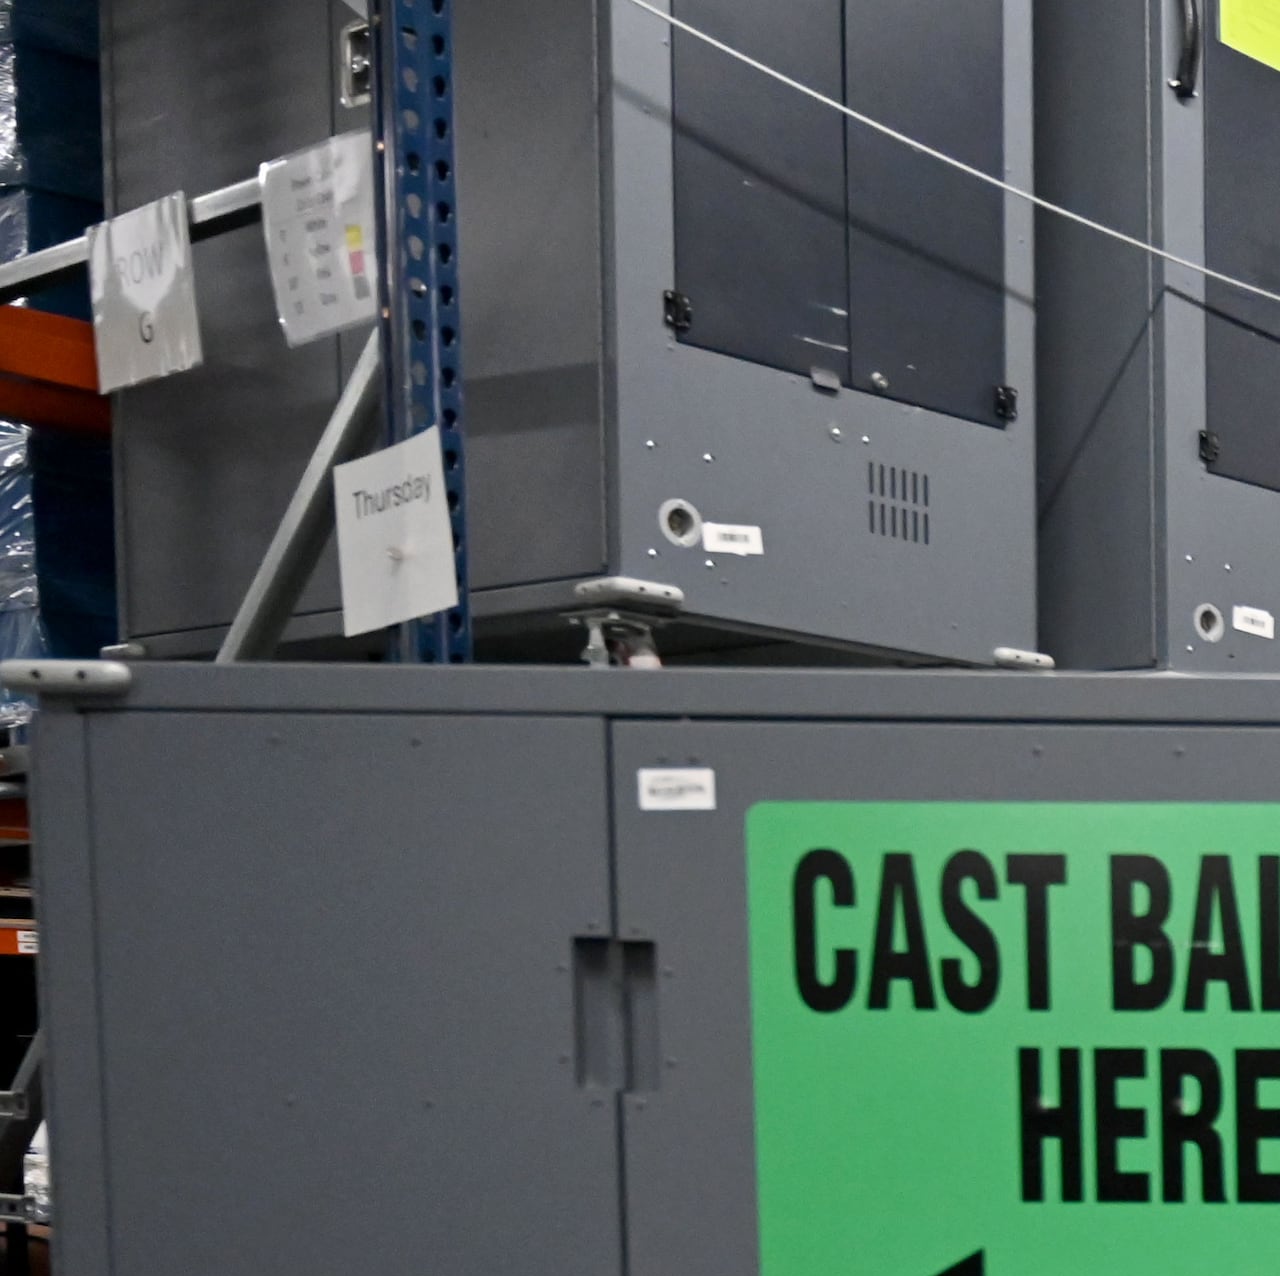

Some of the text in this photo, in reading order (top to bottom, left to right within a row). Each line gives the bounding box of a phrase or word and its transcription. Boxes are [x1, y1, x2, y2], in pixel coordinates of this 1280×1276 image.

[114, 243, 164, 287] ROW
[139, 313, 155, 344] G
[352, 474, 432, 520] Thursday
[791, 848, 1067, 1014] CAST
